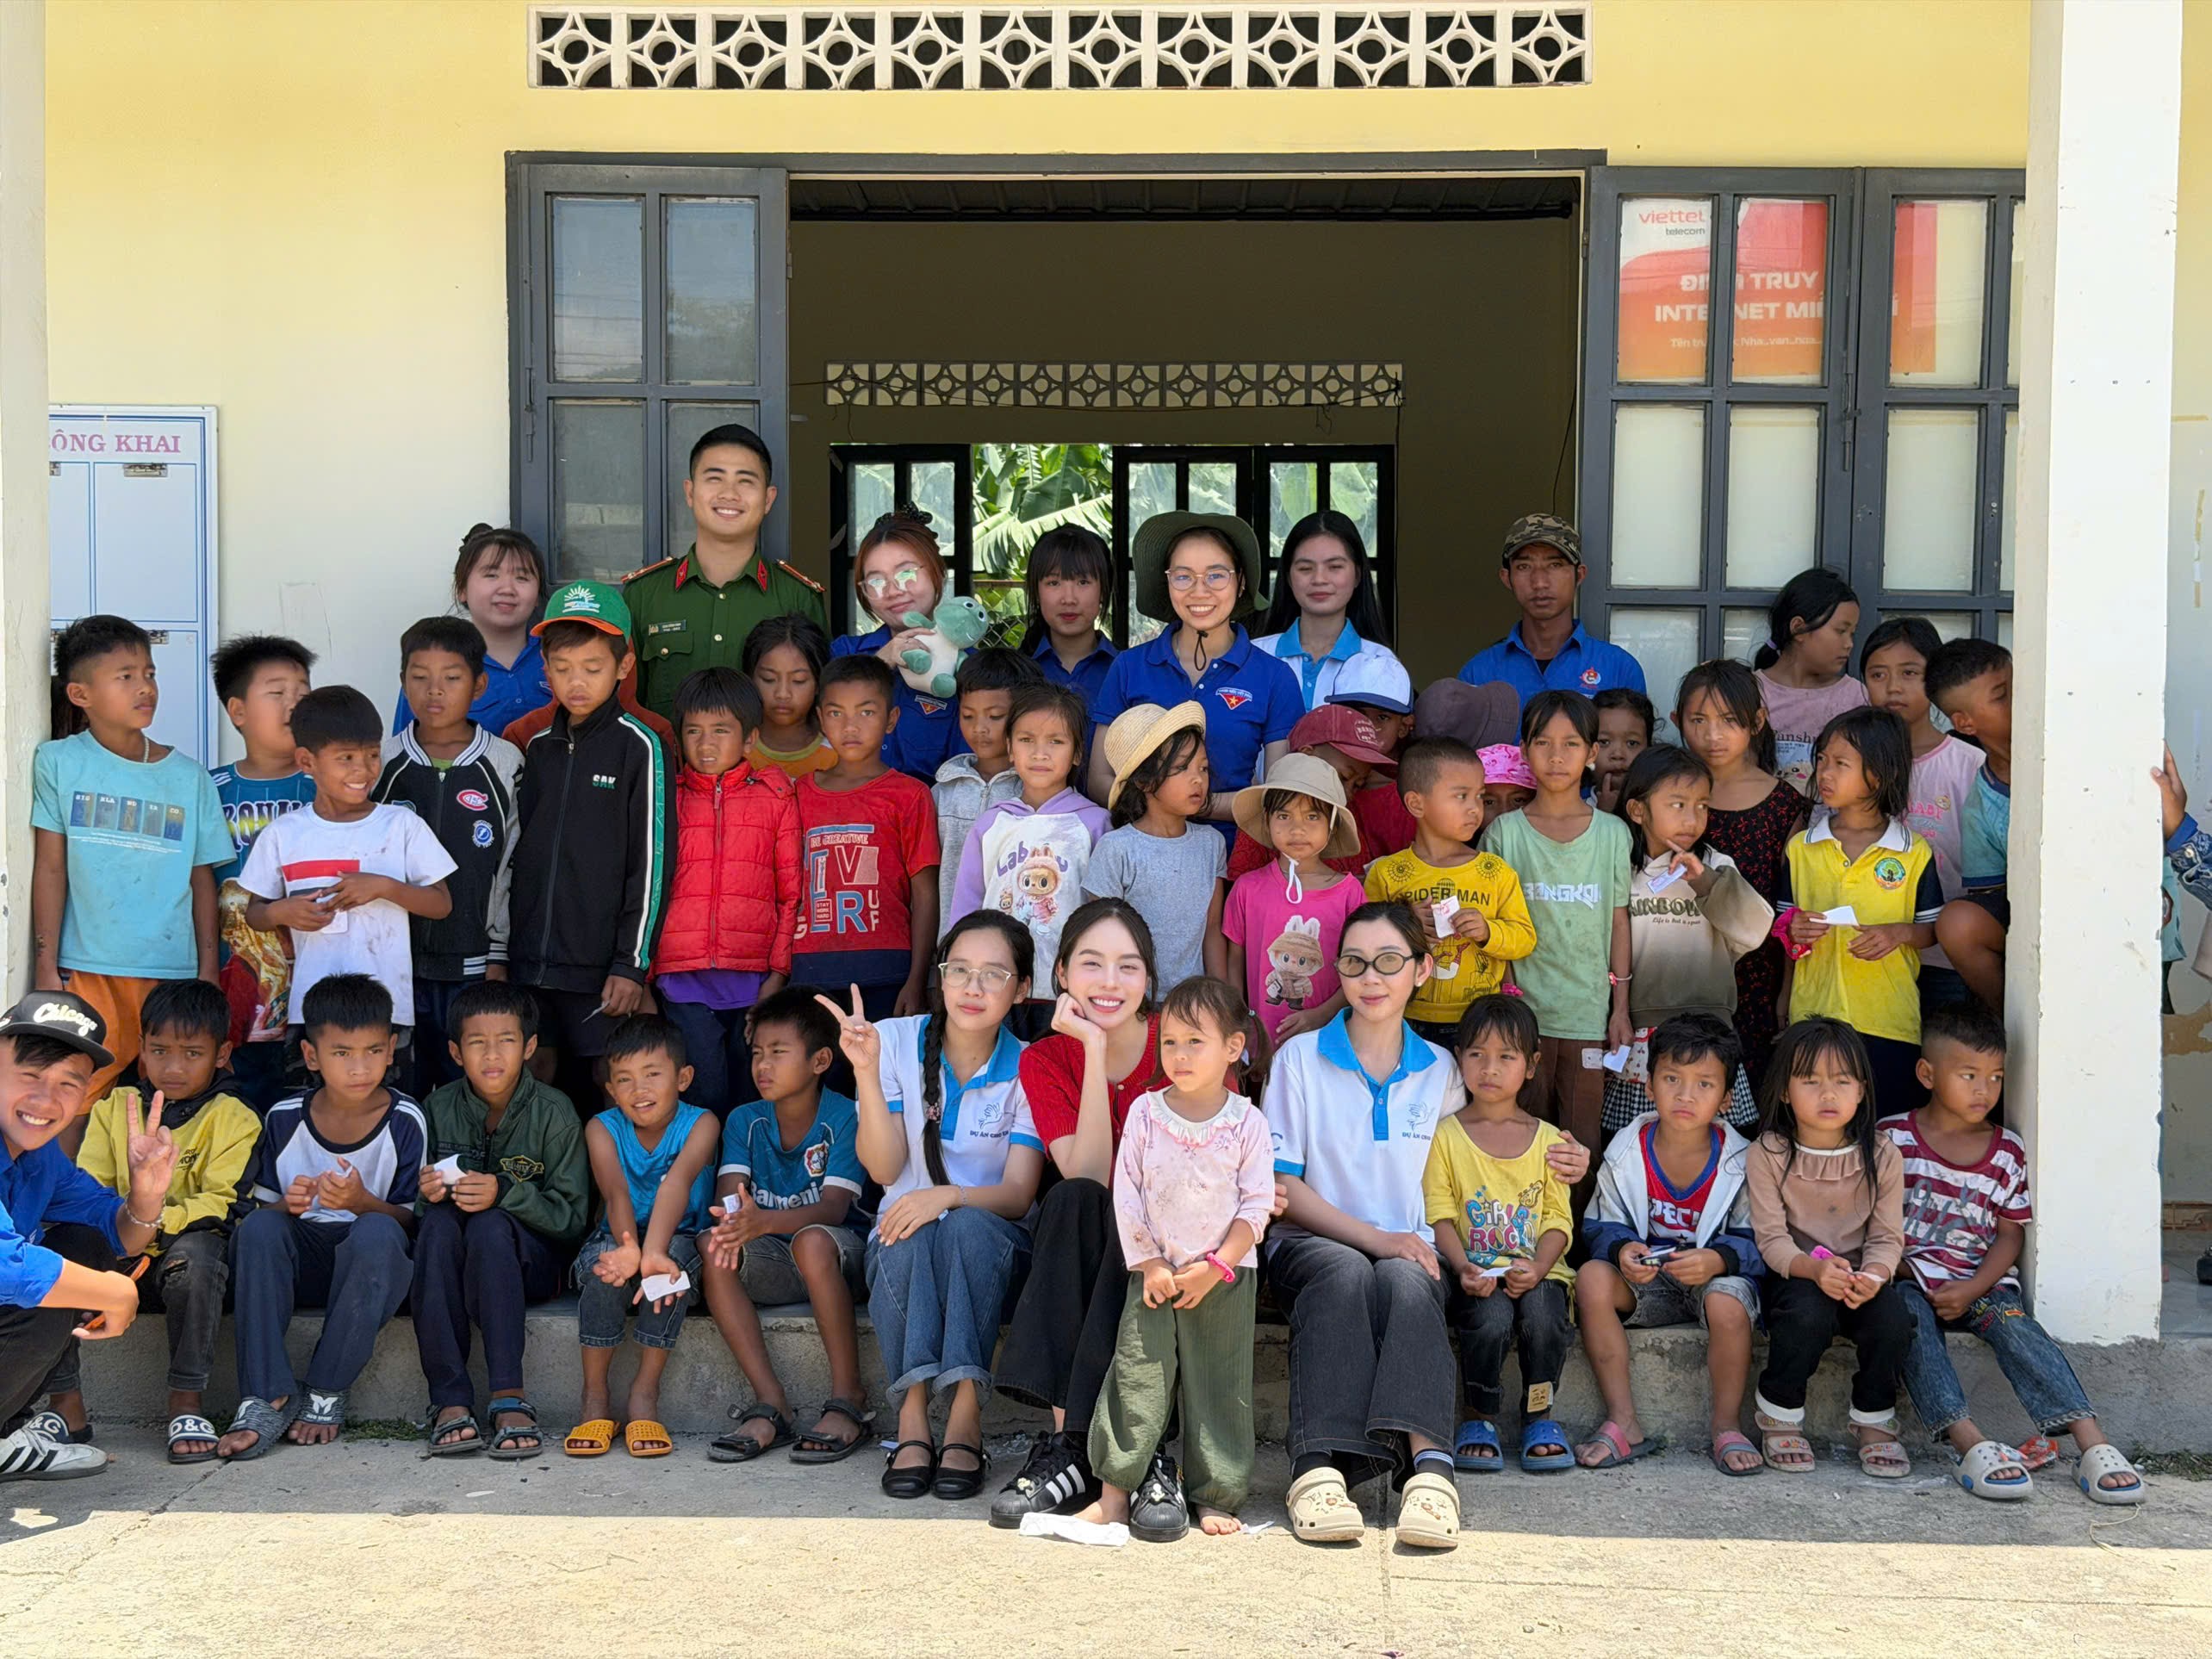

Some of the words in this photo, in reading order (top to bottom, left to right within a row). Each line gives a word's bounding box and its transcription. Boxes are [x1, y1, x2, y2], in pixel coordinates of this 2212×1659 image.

[1638, 209, 1706, 224] viettel
[1749, 271, 1819, 289] TRUY
[1655, 301, 1781, 322] INTENET
[49, 429, 106, 452] ÔNG
[115, 434, 182, 453] KHAI
[823, 834, 869, 845] CREATIVE
[1457, 888, 1491, 906] MAN
[33, 1002, 98, 1037] Chicago
